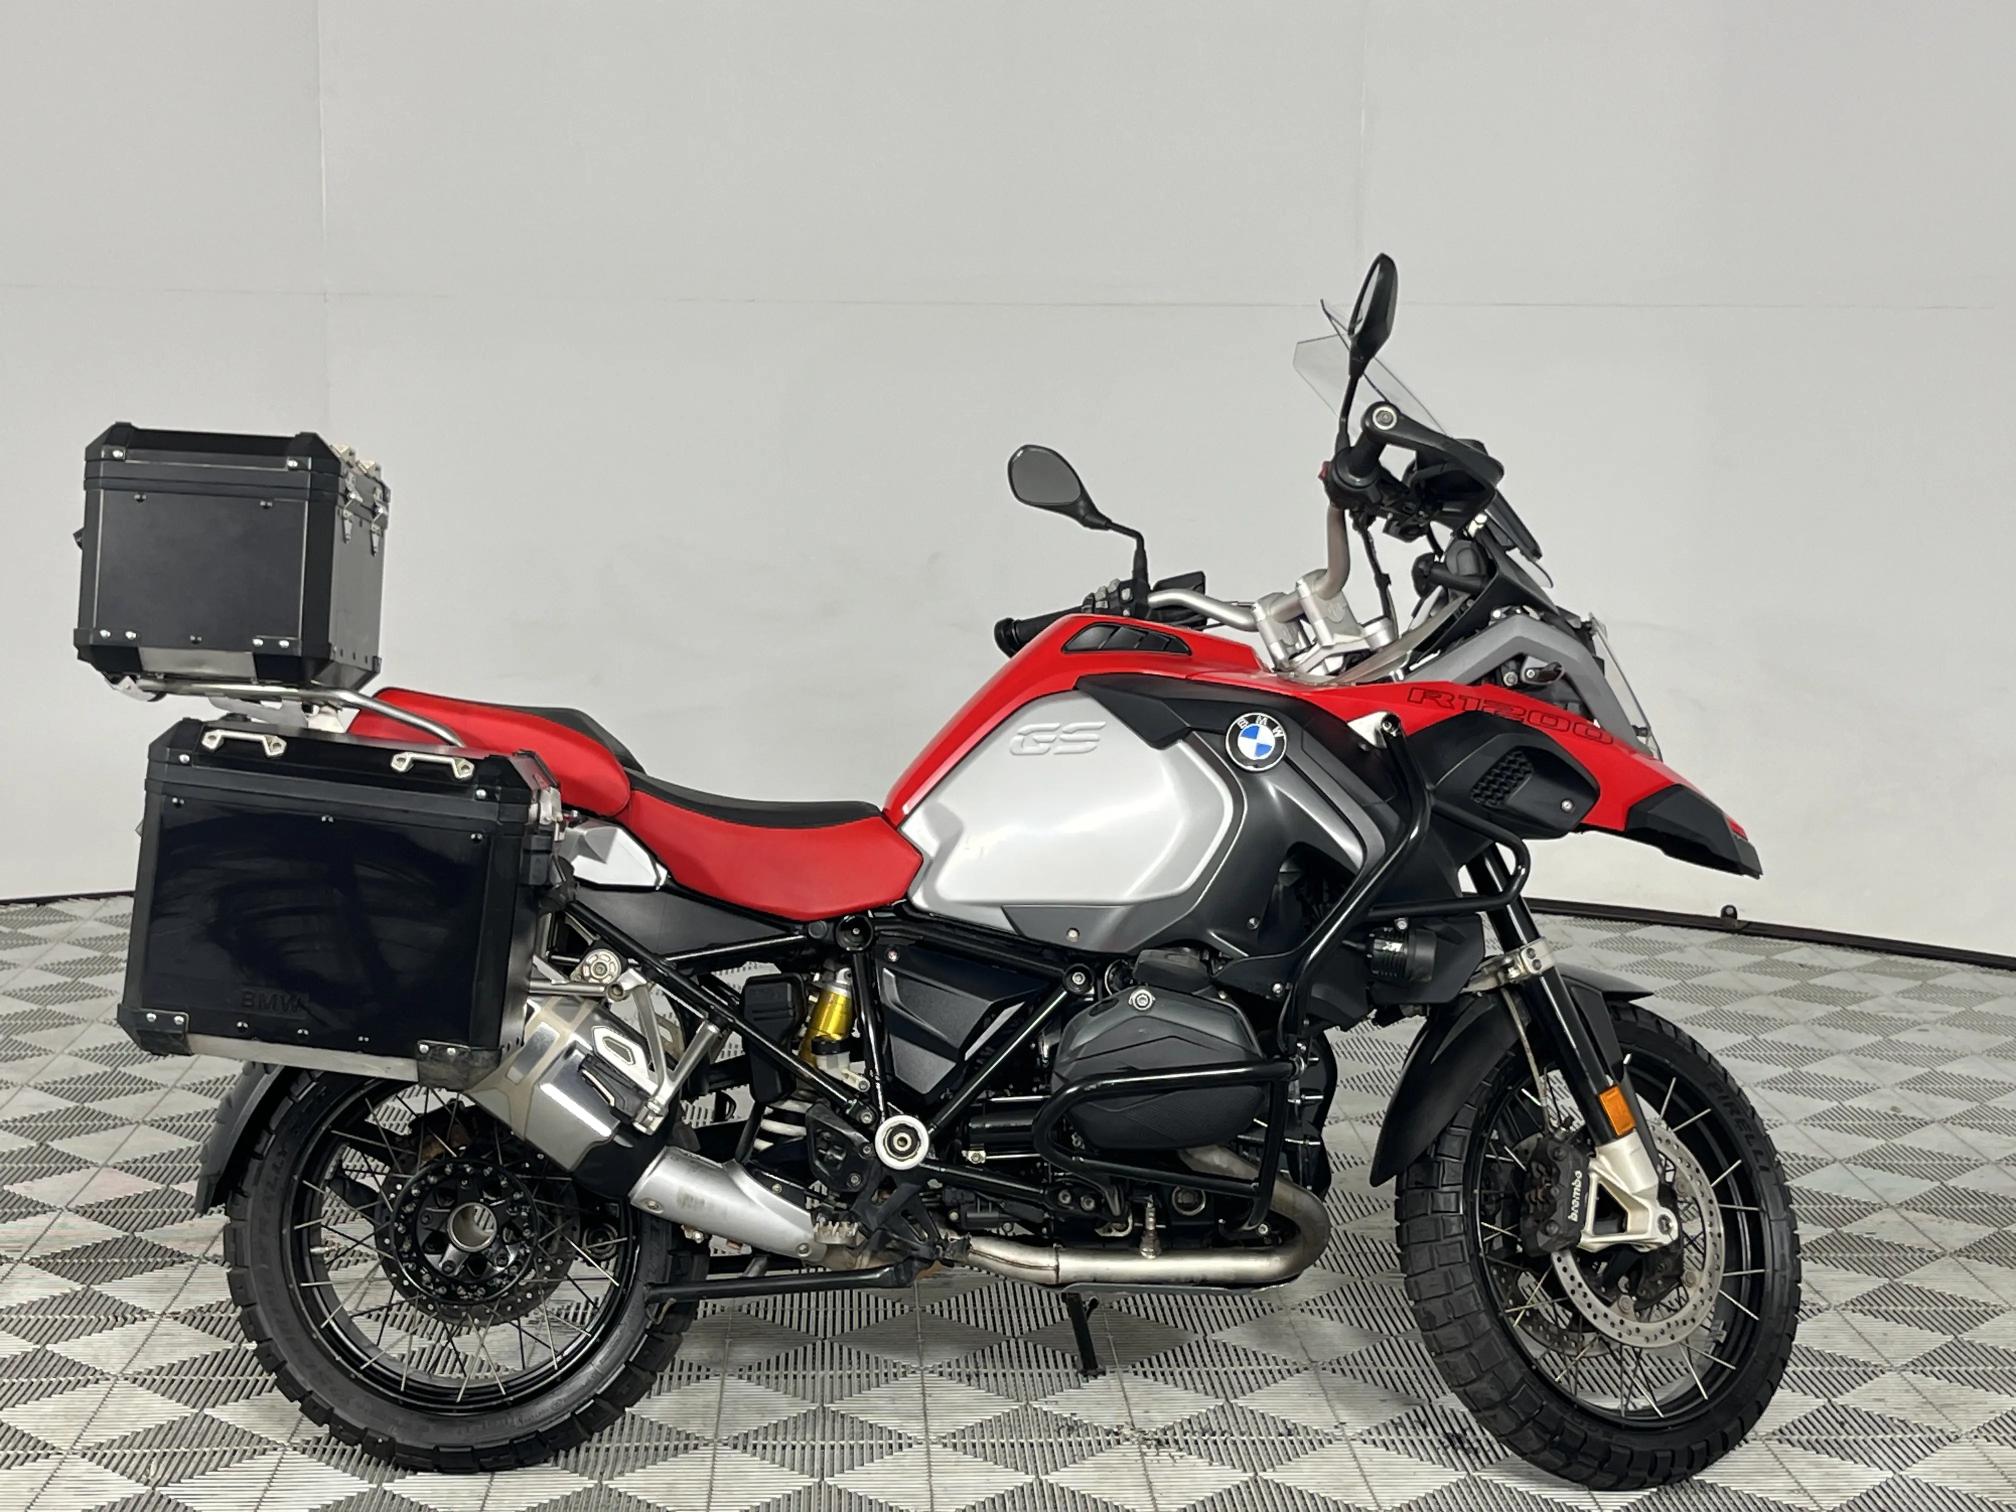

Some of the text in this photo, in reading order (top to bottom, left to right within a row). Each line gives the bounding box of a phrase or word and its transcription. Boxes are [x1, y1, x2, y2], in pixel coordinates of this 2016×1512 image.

[1237, 715, 1285, 738] BMW
[1407, 687, 1614, 745] R1200
[1009, 721, 1106, 756] GS
[240, 989, 304, 1015] BMW
[1706, 1081, 1771, 1172] PIRELLI
[1567, 1170, 1583, 1222] brembo
